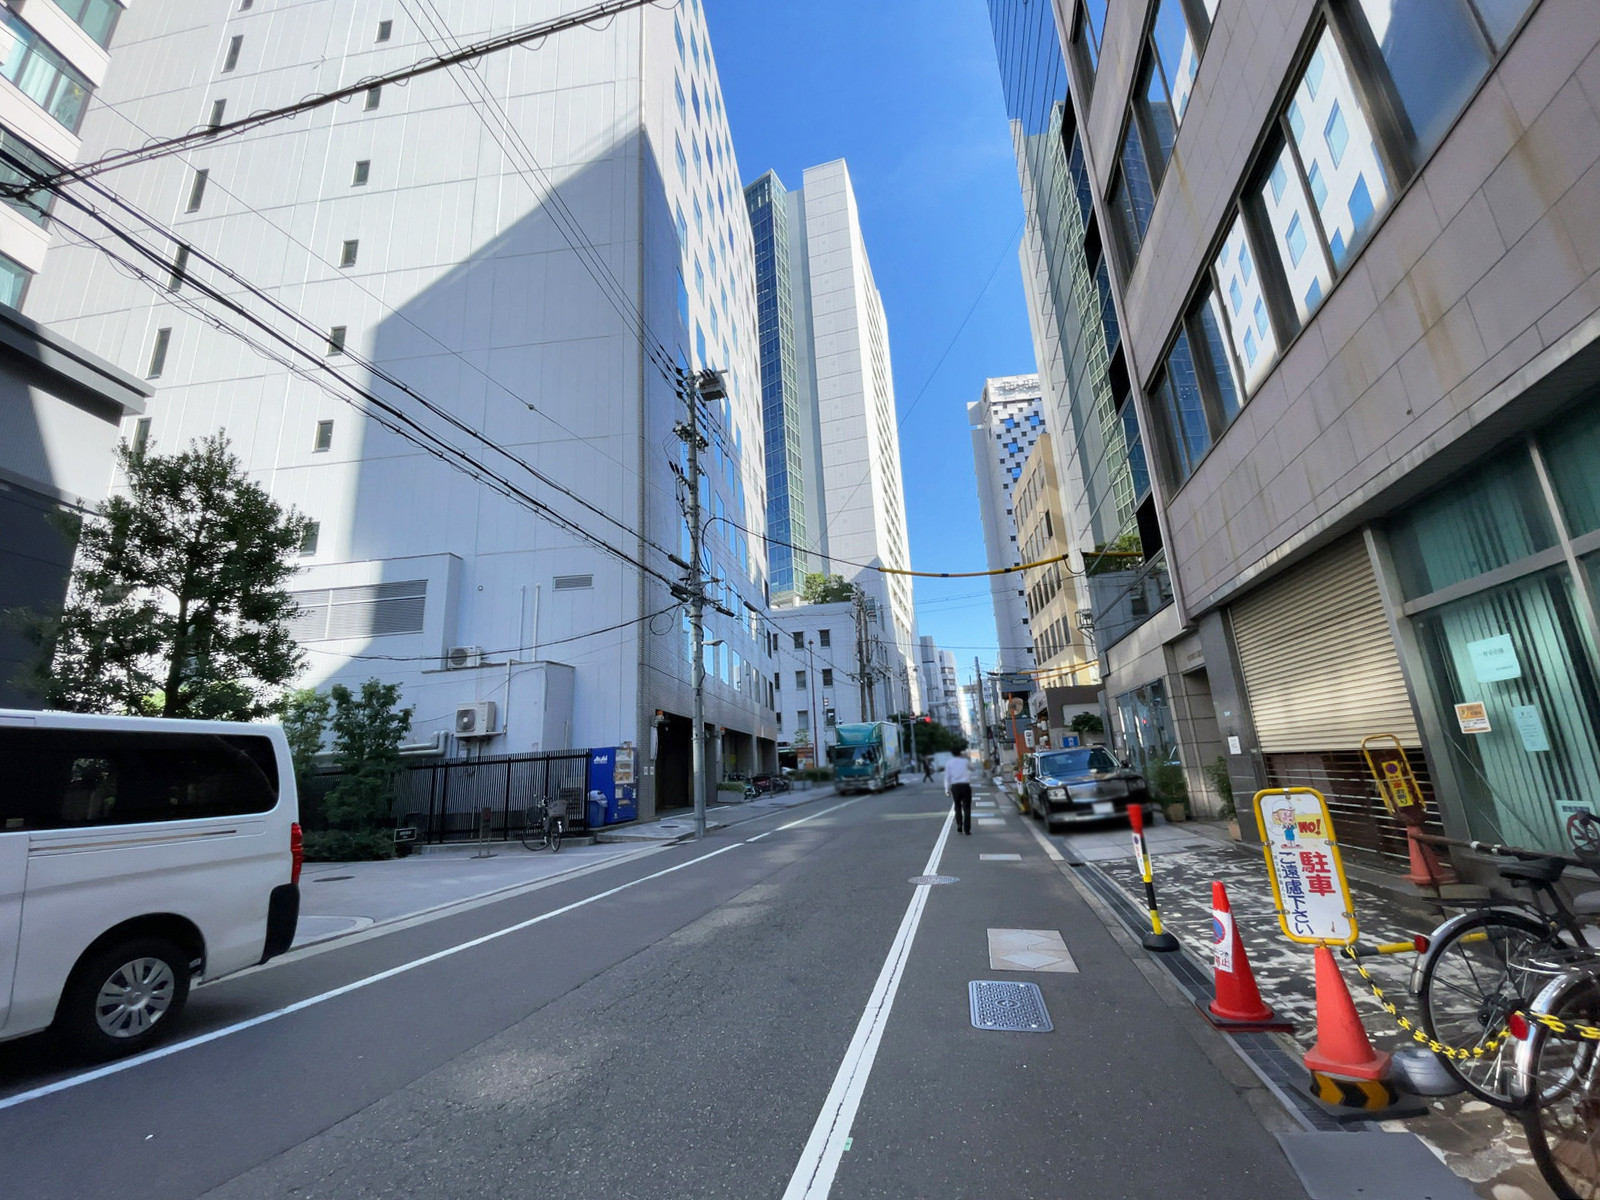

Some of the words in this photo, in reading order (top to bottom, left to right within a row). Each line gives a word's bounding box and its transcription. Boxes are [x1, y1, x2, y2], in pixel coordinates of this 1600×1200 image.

[1297, 819, 1321, 836] NO!
[1279, 851, 1314, 935] ご遠慮下さい
[1299, 851, 1336, 896] 駐車
